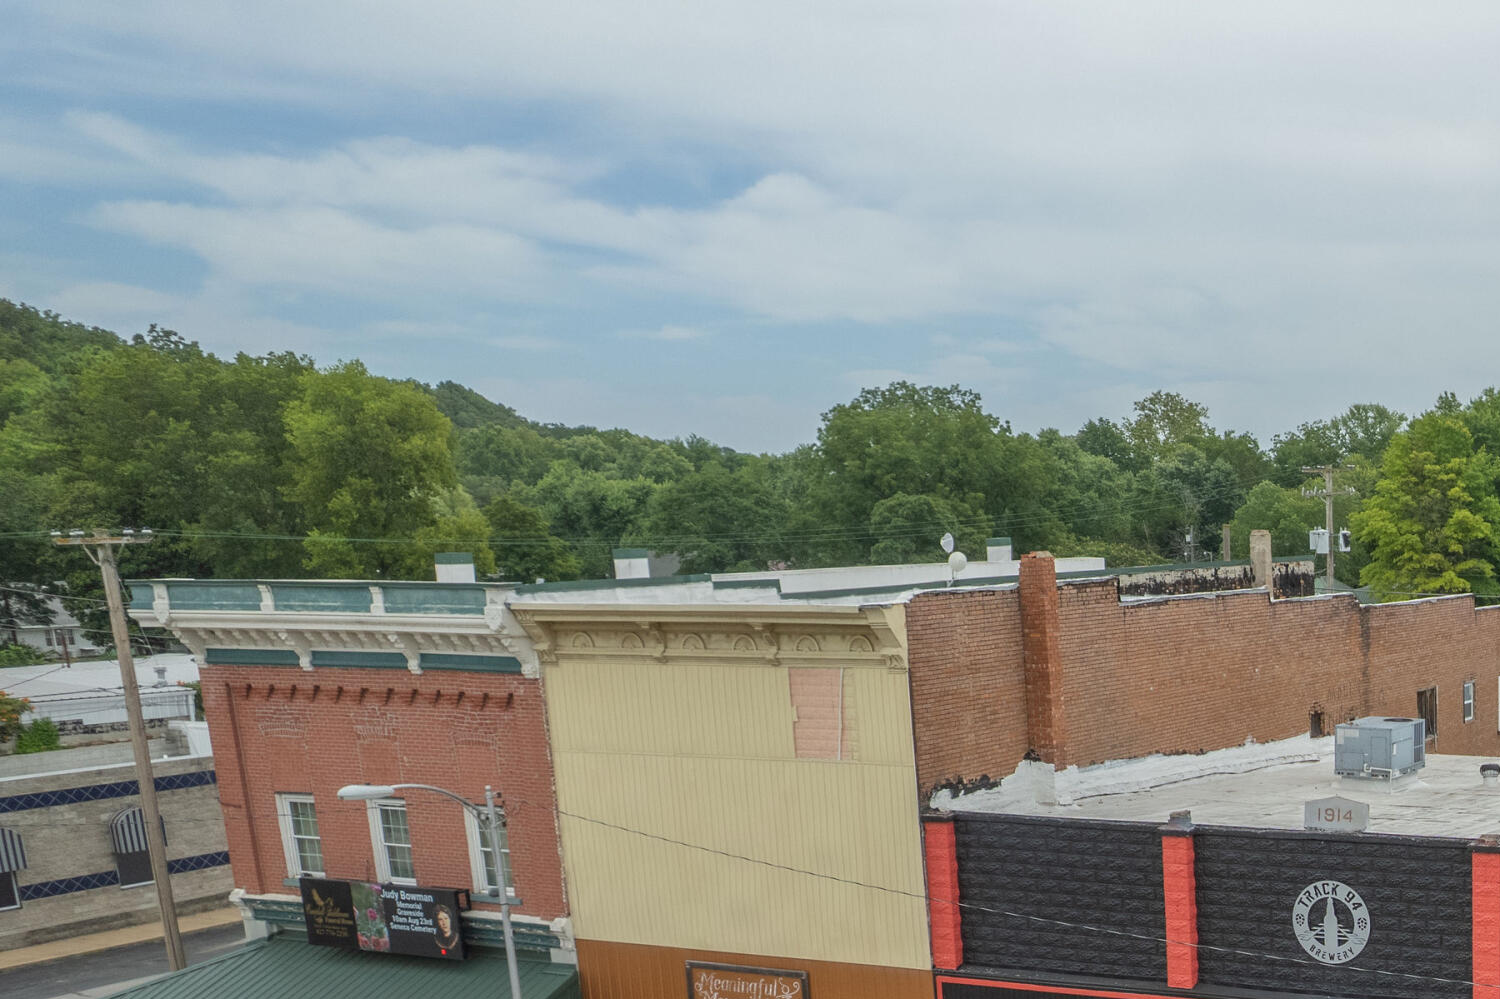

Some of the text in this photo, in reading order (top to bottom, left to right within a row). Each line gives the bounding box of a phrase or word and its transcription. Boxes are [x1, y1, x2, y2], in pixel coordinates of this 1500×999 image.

[1317, 807, 1353, 823] 1914
[380, 889, 434, 903] Judy Bowman
[1297, 882, 1363, 911] TRACK 94
[1309, 944, 1355, 962] BREWERY
